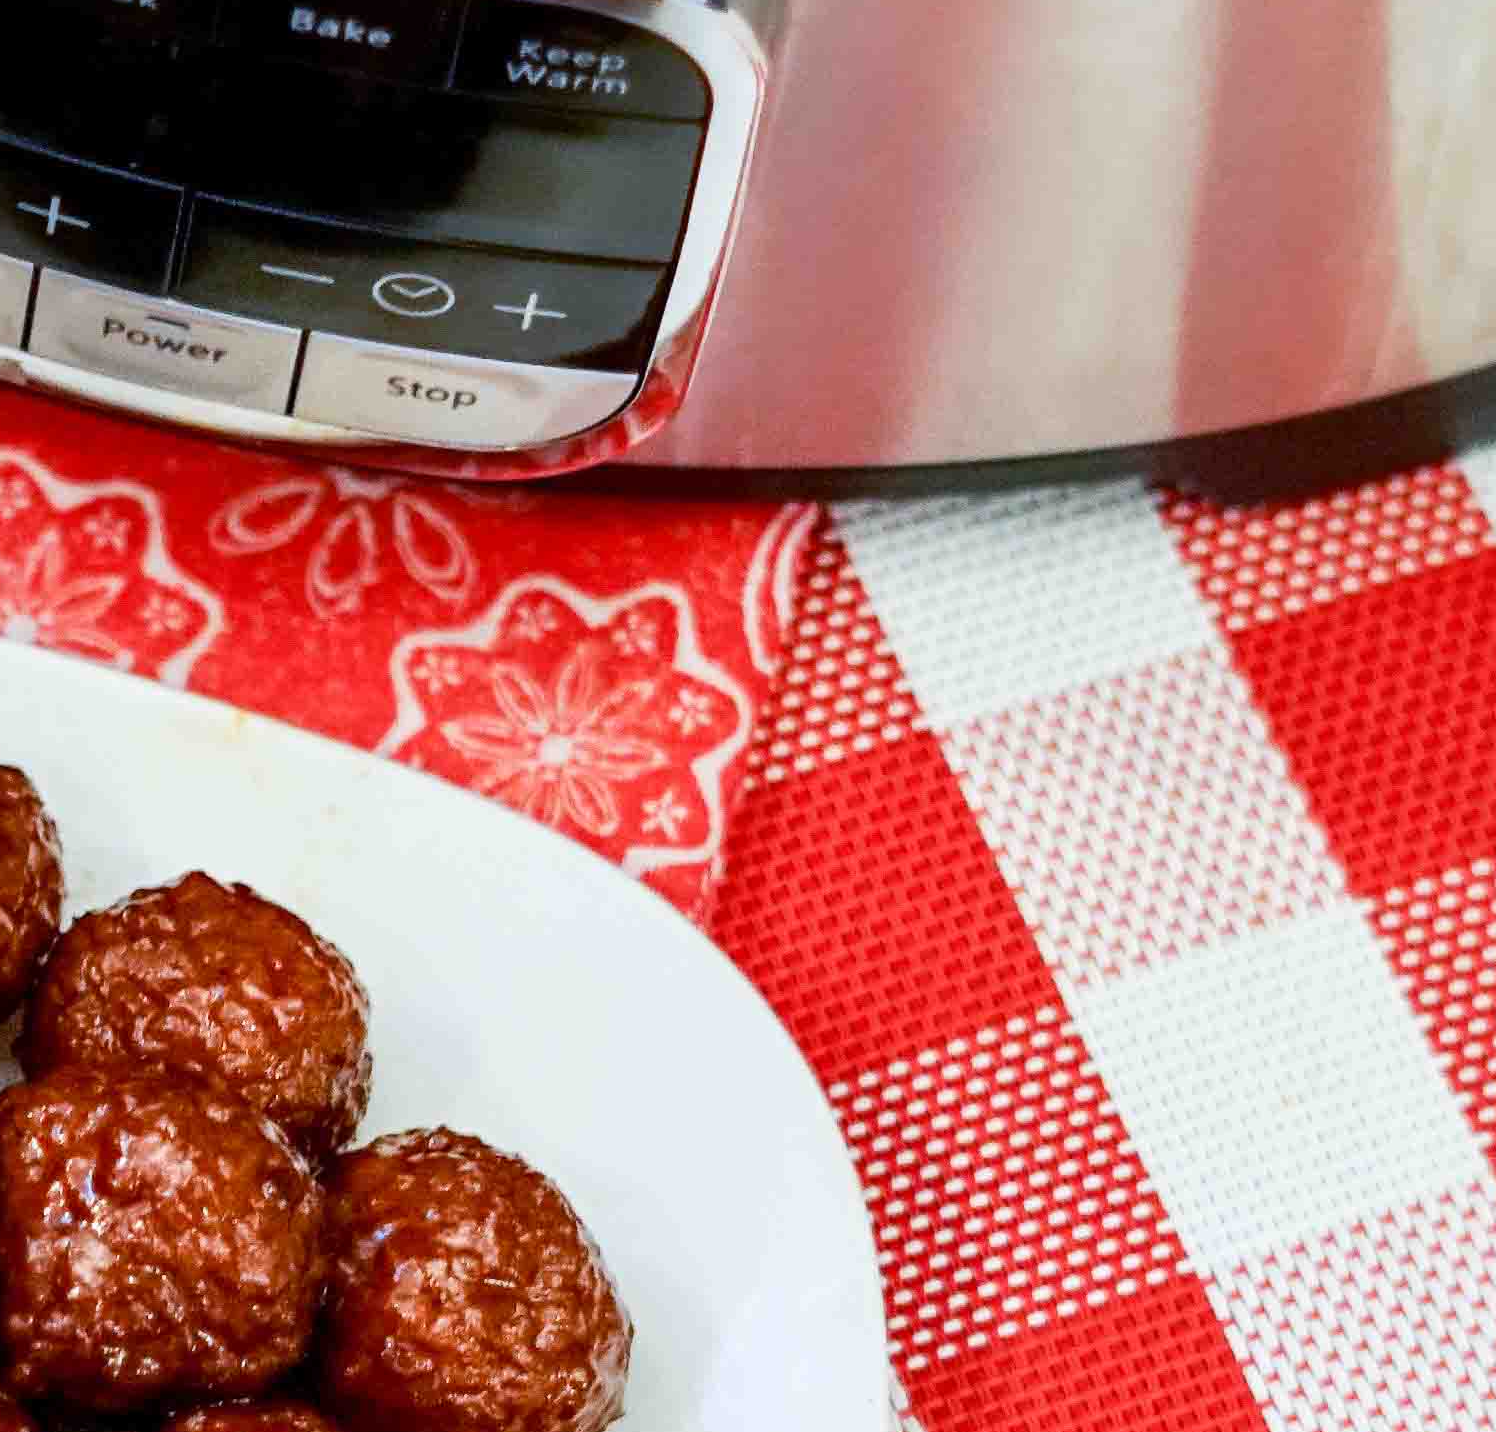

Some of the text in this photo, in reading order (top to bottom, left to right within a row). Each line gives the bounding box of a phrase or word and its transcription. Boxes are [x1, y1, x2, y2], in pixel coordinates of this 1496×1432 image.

[290, 6, 392, 49] Bake
[520, 39, 625, 72] Keep
[507, 62, 628, 95] Warm
[103, 316, 229, 364] Power
[385, 374, 478, 409] Stop
